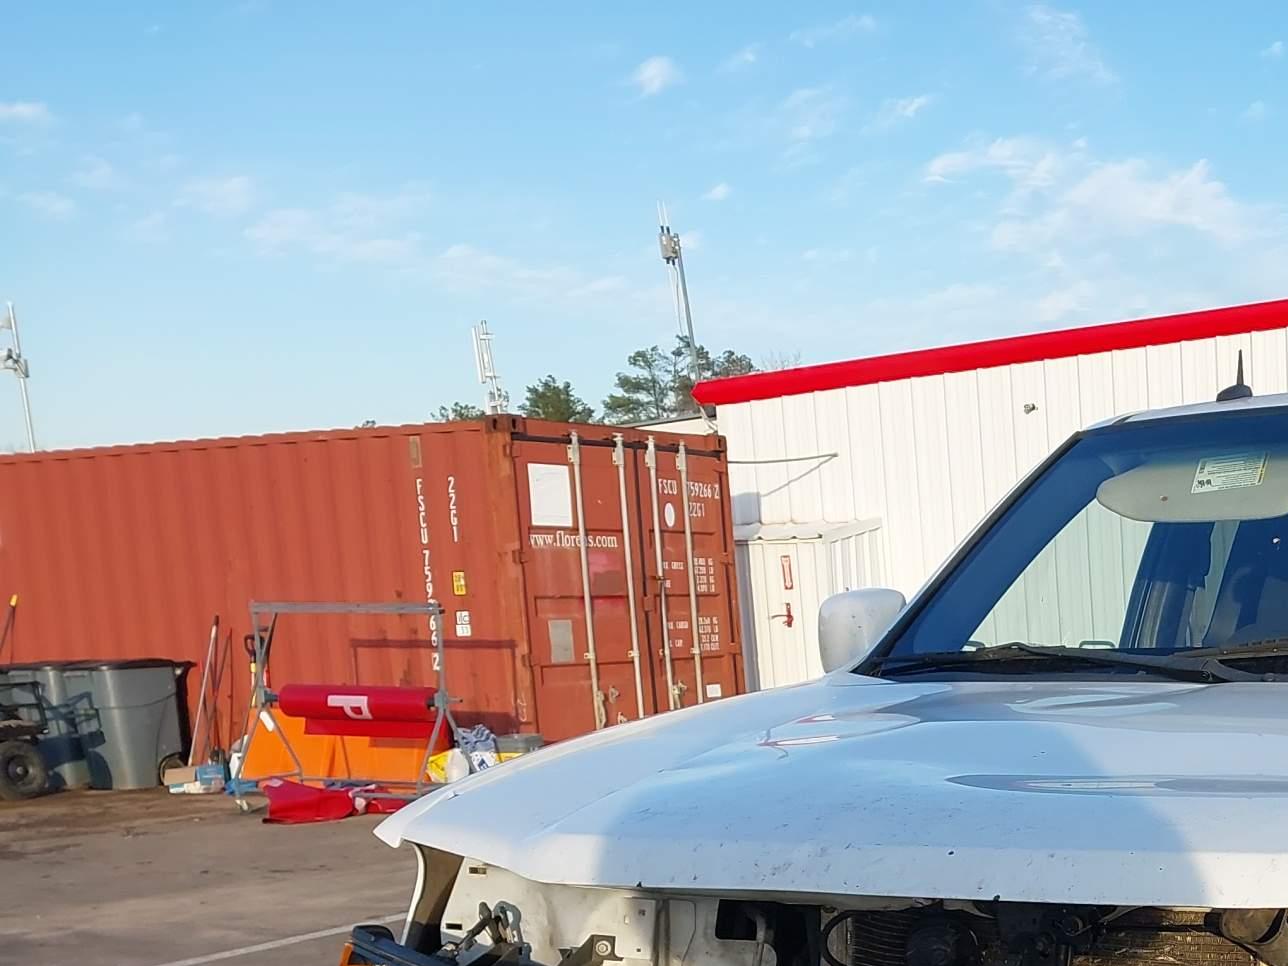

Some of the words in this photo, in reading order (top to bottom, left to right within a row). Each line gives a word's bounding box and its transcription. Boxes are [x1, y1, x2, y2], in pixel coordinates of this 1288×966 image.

[416, 478, 429, 544] FSCU
[658, 478, 678, 495] FSCU
[422, 549, 437, 647] 75966
